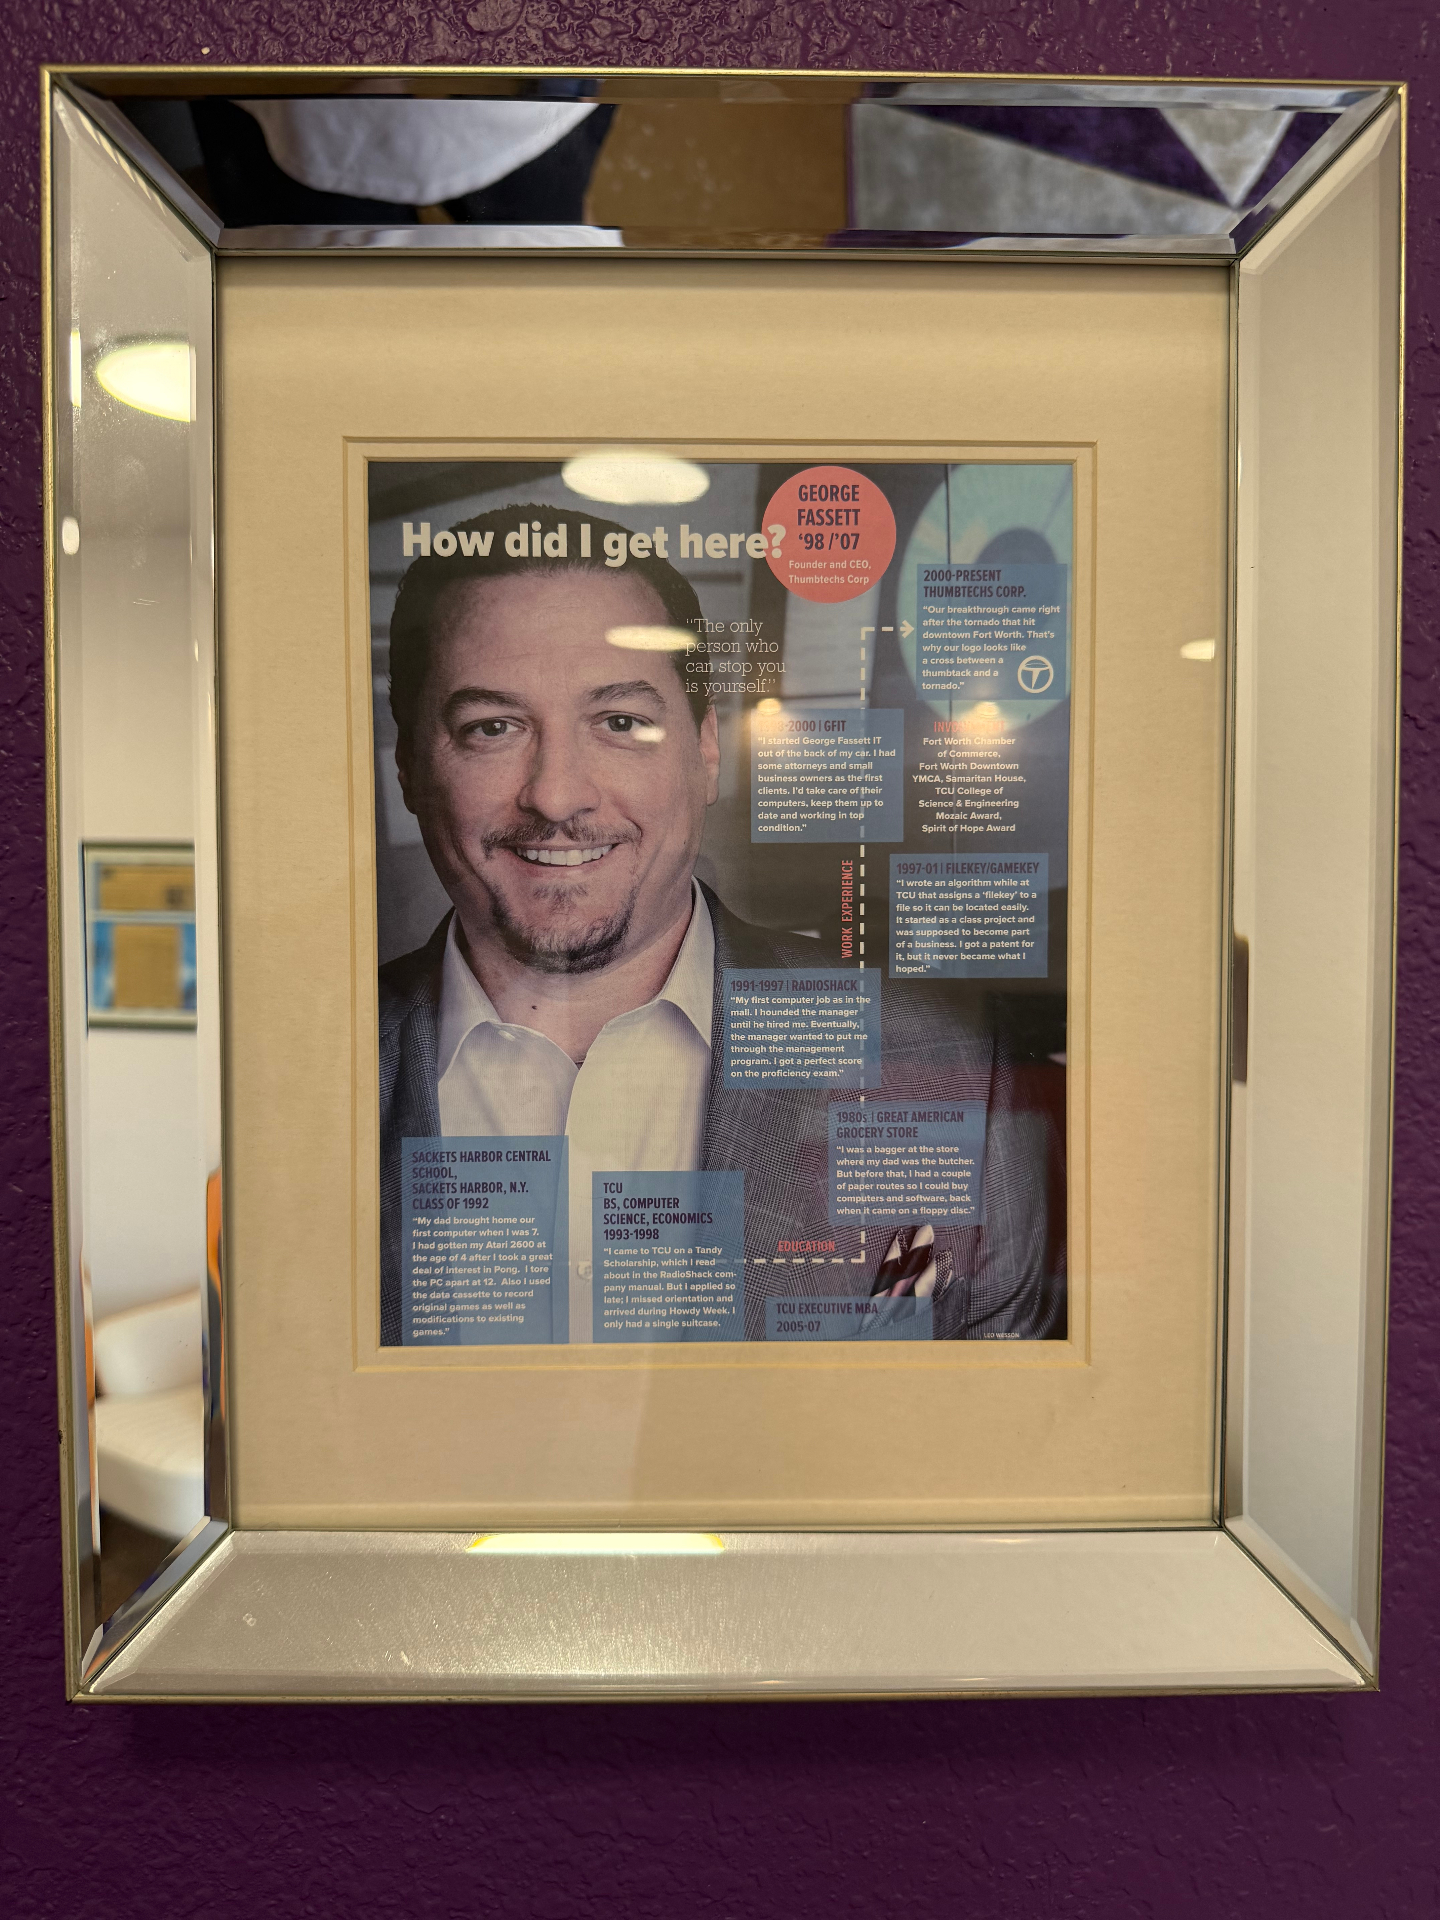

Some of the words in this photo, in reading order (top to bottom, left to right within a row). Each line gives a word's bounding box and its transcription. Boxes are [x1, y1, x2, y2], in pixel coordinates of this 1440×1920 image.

[798, 485, 859, 501] GEORGE
[798, 509, 860, 526] FASSETT
[402, 522, 494, 557] How
[505, 521, 567, 558] did
[580, 523, 591, 558] I
[603, 526, 668, 567] get
[680, 524, 786, 559] here?
[789, 560, 827, 569] Founder
[829, 560, 846, 569] and
[849, 560, 871, 569] CEO,
[789, 575, 844, 583] Thumbtechs
[847, 575, 869, 585] Corp
[924, 570, 1001, 581] 2000-PRESENT
[924, 586, 993, 597] THUMBTECHS
[996, 586, 1026, 597] CORP.
[948, 606, 1009, 615] breakthrough
[1039, 605, 1060, 614] right
[730, 619, 763, 637] only
[685, 643, 741, 656] person
[746, 639, 779, 652] who
[922, 644, 941, 653] why
[961, 644, 981, 653] logo
[686, 663, 714, 672] can
[718, 661, 752, 677] stop
[757, 663, 786, 677] you
[686, 679, 698, 692] is
[824, 721, 846, 731] GFIT
[944, 737, 971, 745] Worth
[949, 750, 1000, 758] Commerce,
[940, 762, 967, 770] Worth
[912, 775, 943, 783] YMCA,
[995, 775, 1026, 783] House,
[957, 787, 991, 796] College
[758, 799, 808, 808] computers,
[811, 799, 832, 808] keep
[965, 799, 1019, 808] Engineering
[970, 812, 1002, 820] Award,
[922, 824, 946, 833] Spirit
[960, 824, 984, 833] Hope
[897, 863, 938, 874] 1997-01
[946, 862, 1039, 874] FILEKEY/GAMEKEY
[841, 860, 853, 922] EXPERIENCE
[896, 891, 915, 899] TCU
[939, 891, 972, 900] assigns
[841, 927, 853, 959] WORK
[731, 980, 783, 991] 1991-1997
[792, 980, 857, 991] RADIOSHACK
[731, 1045, 766, 1054] through
[786, 1045, 844, 1054] management
[779, 1058, 794, 1066] got
[804, 1057, 835, 1066] perfect
[837, 1112, 867, 1122] 1980s
[877, 1112, 908, 1122] GREAT
[911, 1112, 963, 1122] AMERICAN
[837, 1127, 884, 1138] GROCERY
[887, 1127, 918, 1137] STORE
[413, 1152, 457, 1162] SACKETS
[460, 1151, 503, 1162] HARBOR
[506, 1151, 551, 1162] CENTRAL
[413, 1168, 457, 1180] SCHOOL,
[413, 1183, 457, 1193] SACKETS
[460, 1183, 506, 1195] HARBOR,
[510, 1182, 528, 1193] N.Y.
[604, 1183, 622, 1193] TCU
[413, 1199, 443, 1209] CLASS
[447, 1198, 460, 1209] OF
[463, 1198, 489, 1209] 1992
[604, 1198, 620, 1210] BS,
[623, 1198, 679, 1208] COMPUTER
[453, 1217, 489, 1226] brought
[604, 1214, 649, 1226] SCIENCE,
[653, 1213, 712, 1223] ECONOMICS
[433, 1229, 477, 1238] computer
[604, 1229, 659, 1240] 1993-1998
[778, 1241, 835, 1251] EDUCATION
[604, 1259, 659, 1268] Scholarship,
[661, 1258, 687, 1266] which
[604, 1271, 630, 1279] about
[776, 1304, 795, 1314] TCU
[798, 1304, 852, 1314] EXECUTIVE
[855, 1304, 878, 1314] MBA
[776, 1322, 820, 1332] 2005-07
